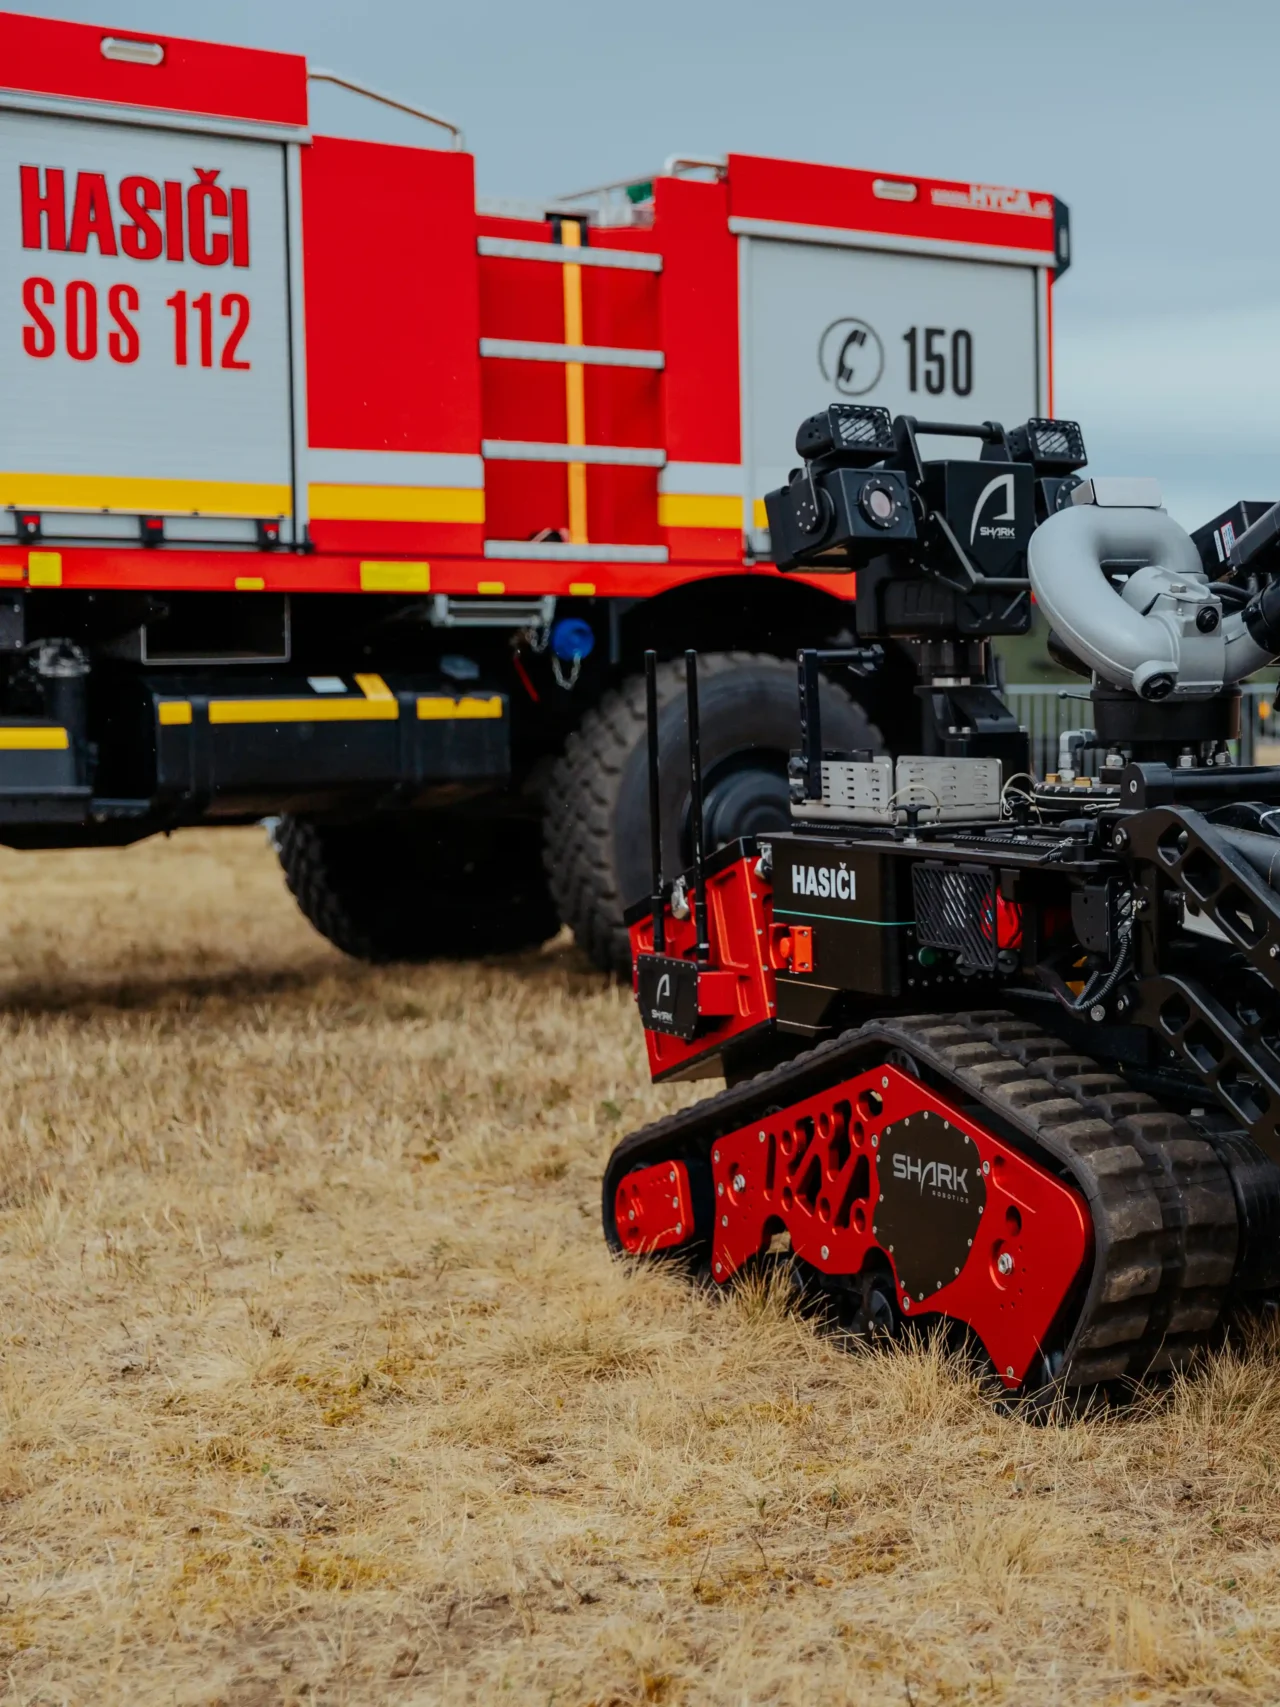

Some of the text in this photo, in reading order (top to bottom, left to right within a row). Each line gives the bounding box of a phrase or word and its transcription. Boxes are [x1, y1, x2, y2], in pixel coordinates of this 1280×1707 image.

[19, 164, 250, 269] HASIČI
[22, 276, 251, 370] SOS 112
[903, 326, 972, 396] 150
[980, 526, 1015, 540] SHARK
[791, 861, 856, 900] HASIČI
[892, 1153, 969, 1196] SHARK
[932, 1190, 969, 1204] ROBOTICS
